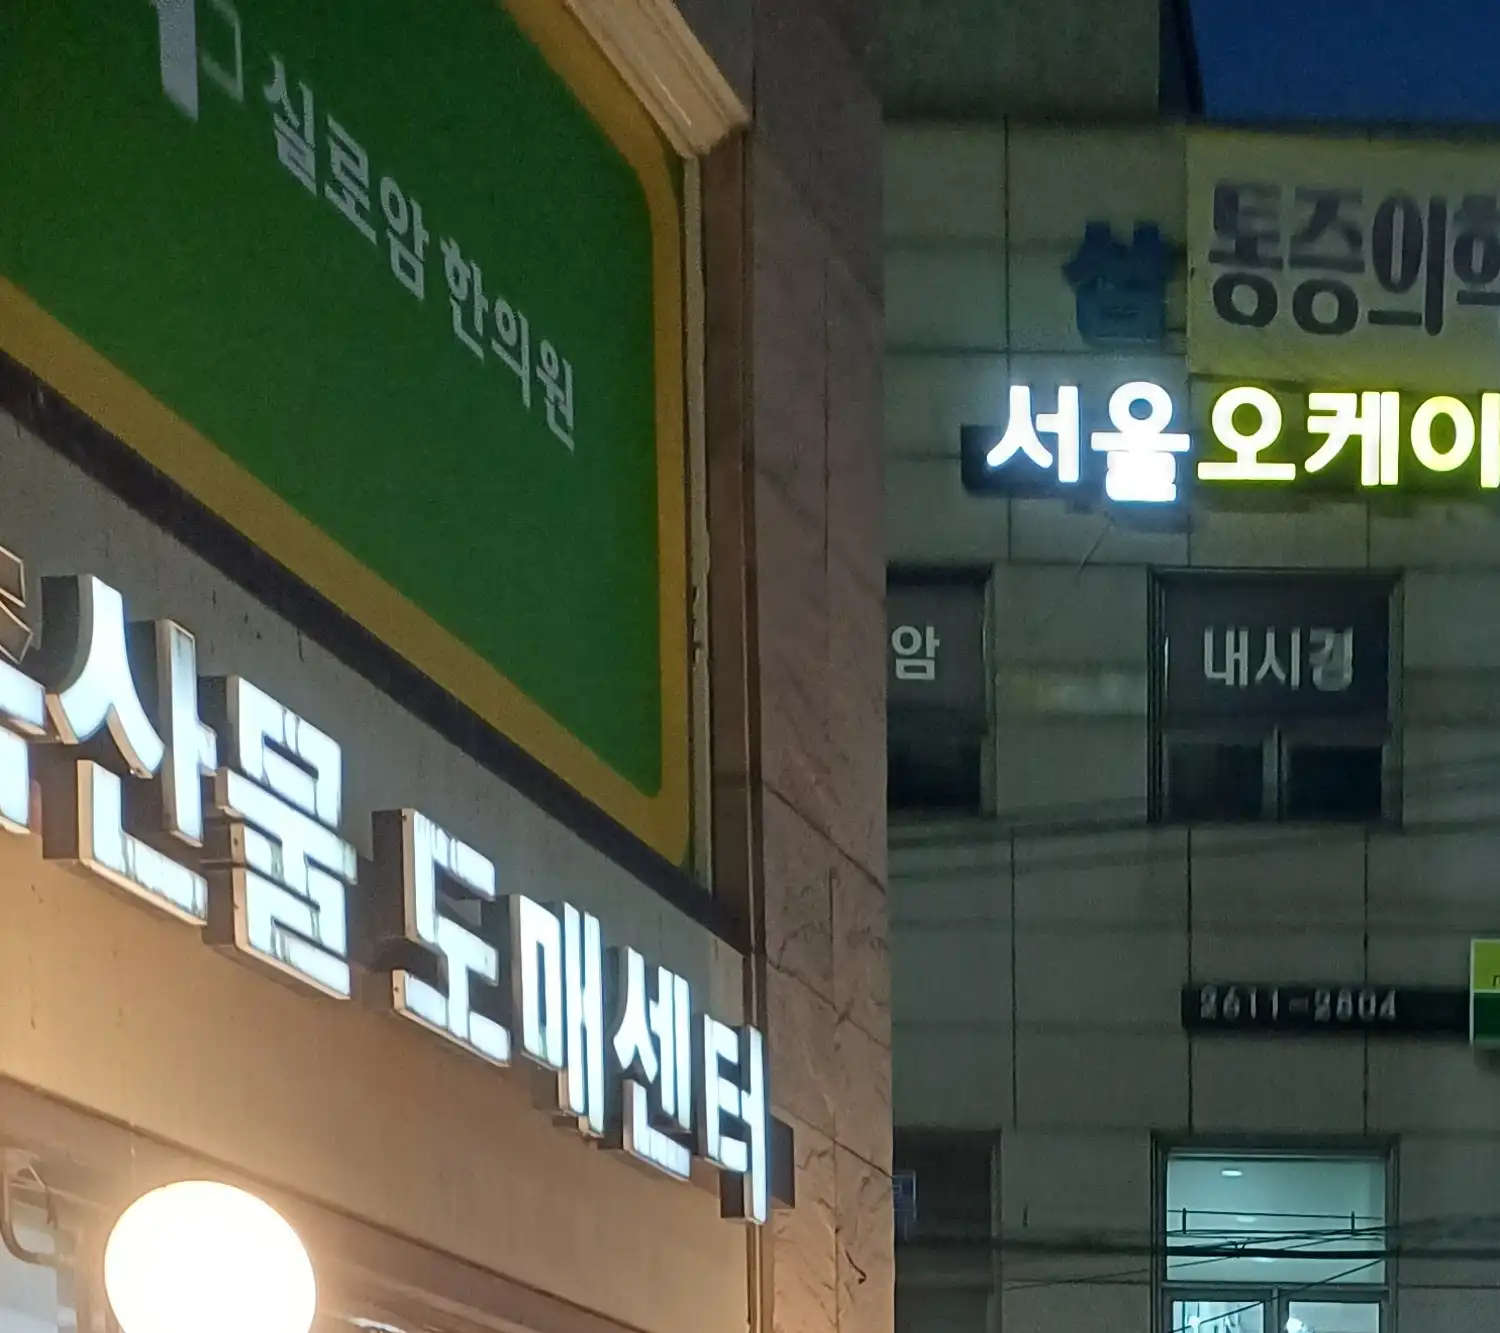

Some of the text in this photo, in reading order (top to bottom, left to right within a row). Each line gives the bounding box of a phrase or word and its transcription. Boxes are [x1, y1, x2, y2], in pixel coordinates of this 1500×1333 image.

[263, 53, 576, 451] 실로암 한의원
[393, 808, 768, 1225] 도매센터
